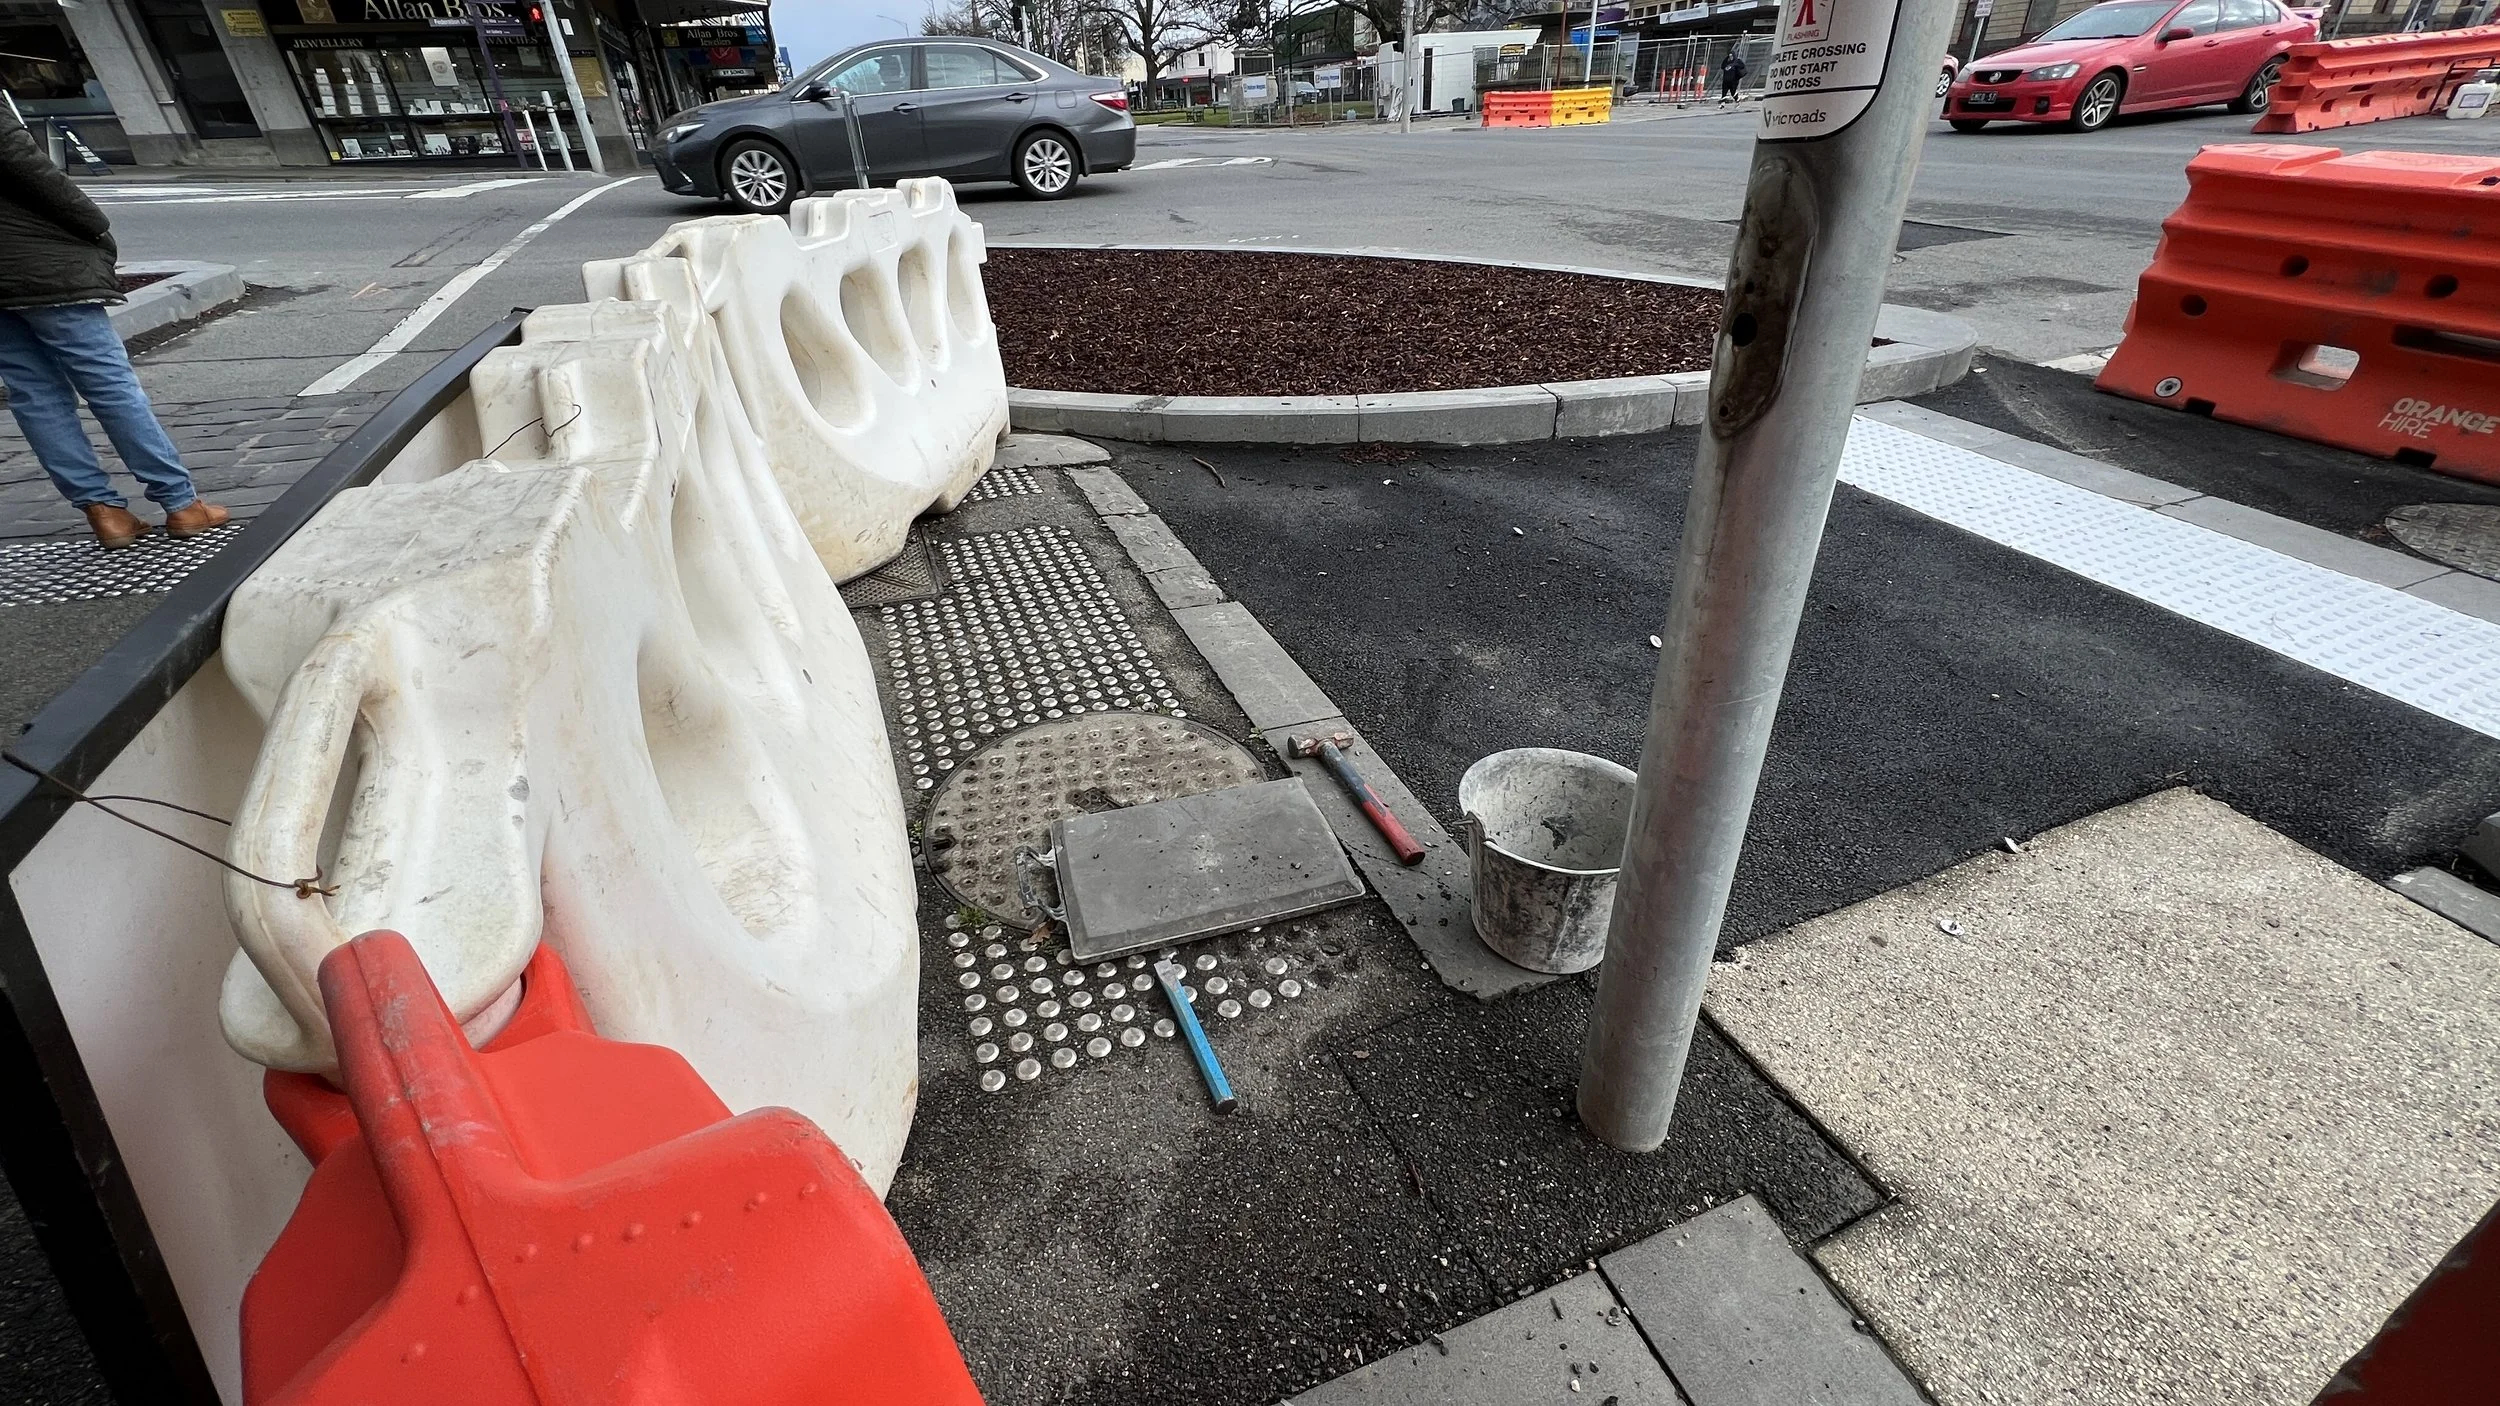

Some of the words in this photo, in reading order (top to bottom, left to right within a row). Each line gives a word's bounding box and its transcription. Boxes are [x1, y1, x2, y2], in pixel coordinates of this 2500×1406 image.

[364, 0, 435, 20] Allan
[485, 35, 538, 45] WATCHES
[687, 28, 712, 39] Allan
[1787, 29, 1820, 41] FLASHING
[293, 38, 363, 48] JEWELLERY
[1801, 42, 1867, 60] CROSSING
[1779, 65, 1798, 76] NOT
[1799, 60, 1838, 75] START
[1773, 80, 1782, 91] TO
[1785, 76, 1821, 89] CROSS
[2393, 397, 2500, 434] ORANGE
[2378, 412, 2438, 439] HIRE
